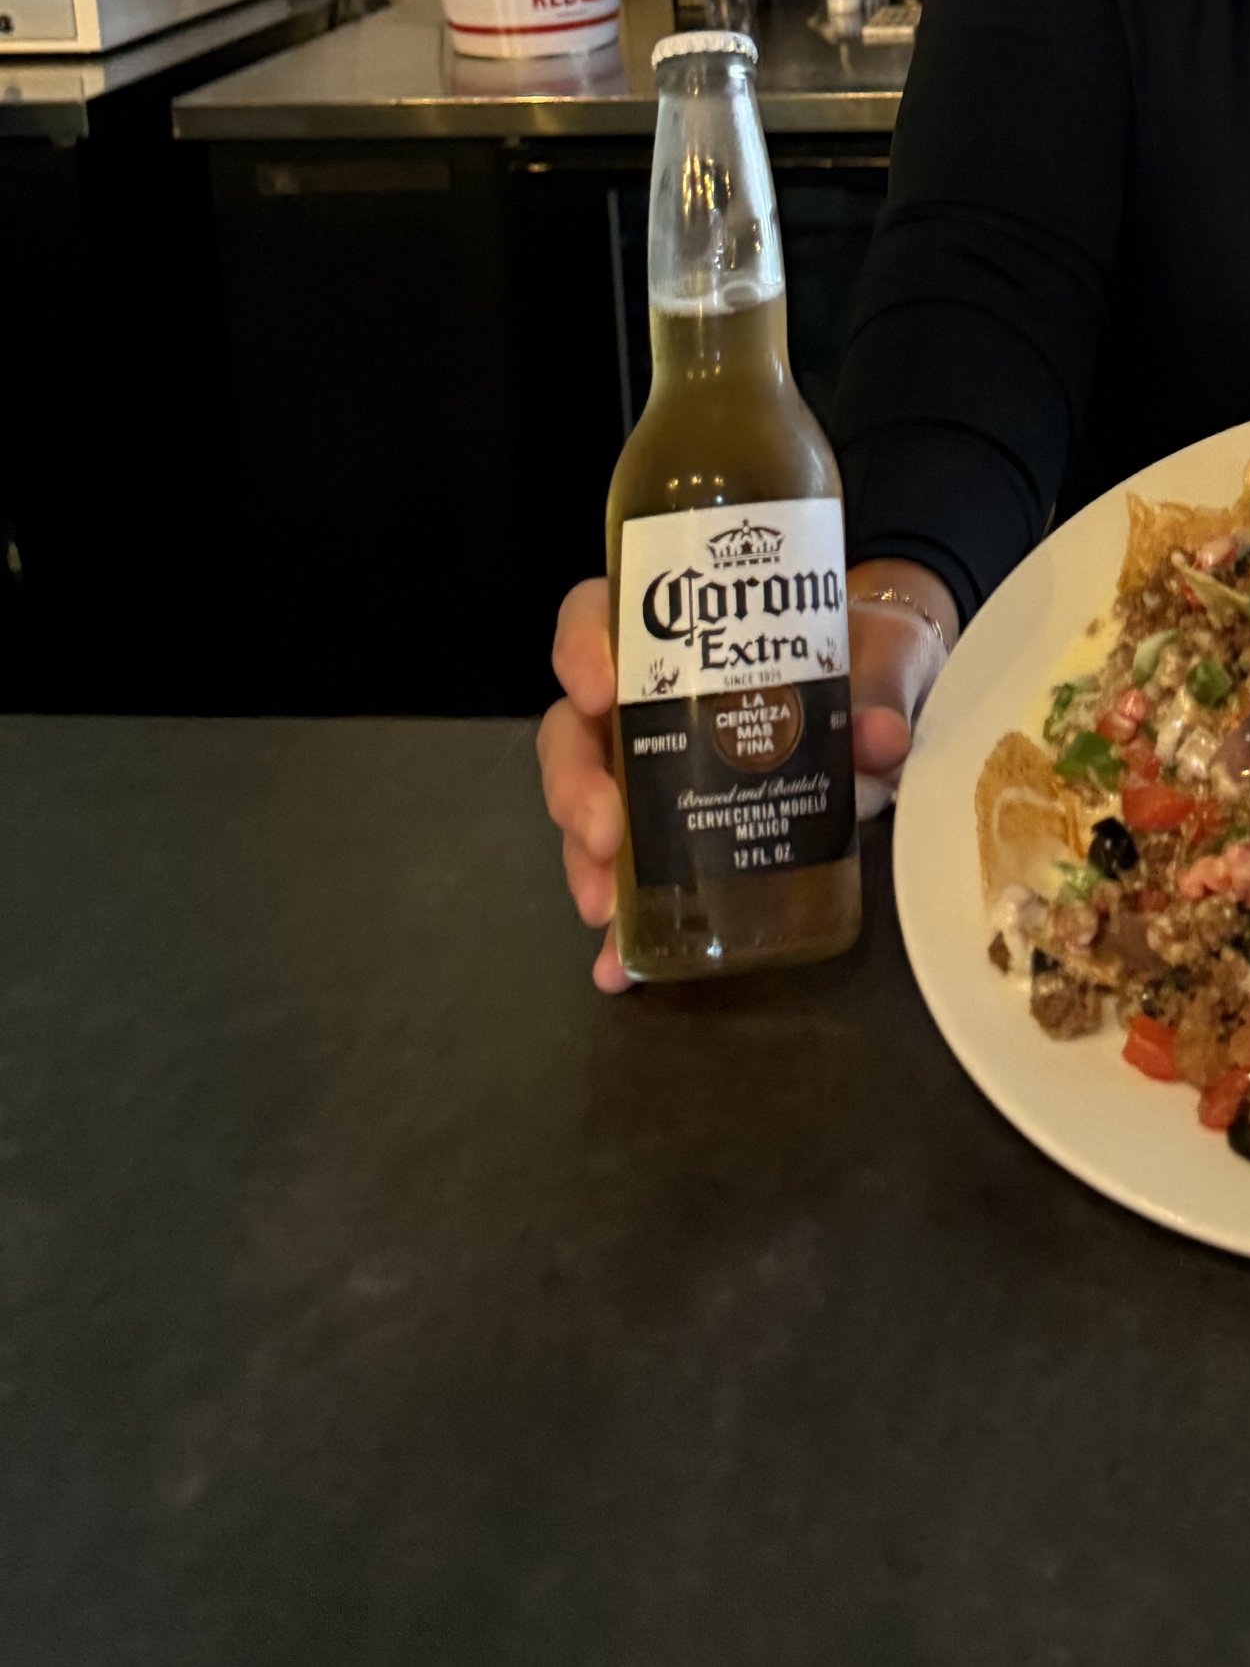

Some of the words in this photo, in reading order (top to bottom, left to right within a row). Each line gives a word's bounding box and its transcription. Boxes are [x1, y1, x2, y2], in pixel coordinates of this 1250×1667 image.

[642, 565, 839, 648] Corona
[697, 625, 810, 672] Extra
[741, 691, 766, 709] LA
[715, 703, 791, 729] CERVEZA
[633, 731, 688, 756] IMPORTED
[736, 737, 775, 758] FINA
[677, 784, 735, 810] Brewed
[736, 779, 768, 802] and
[687, 801, 777, 831] CERVECERIA
[779, 794, 828, 817] MODELO
[735, 817, 790, 842] MEXICO
[734, 847, 749, 870] 12
